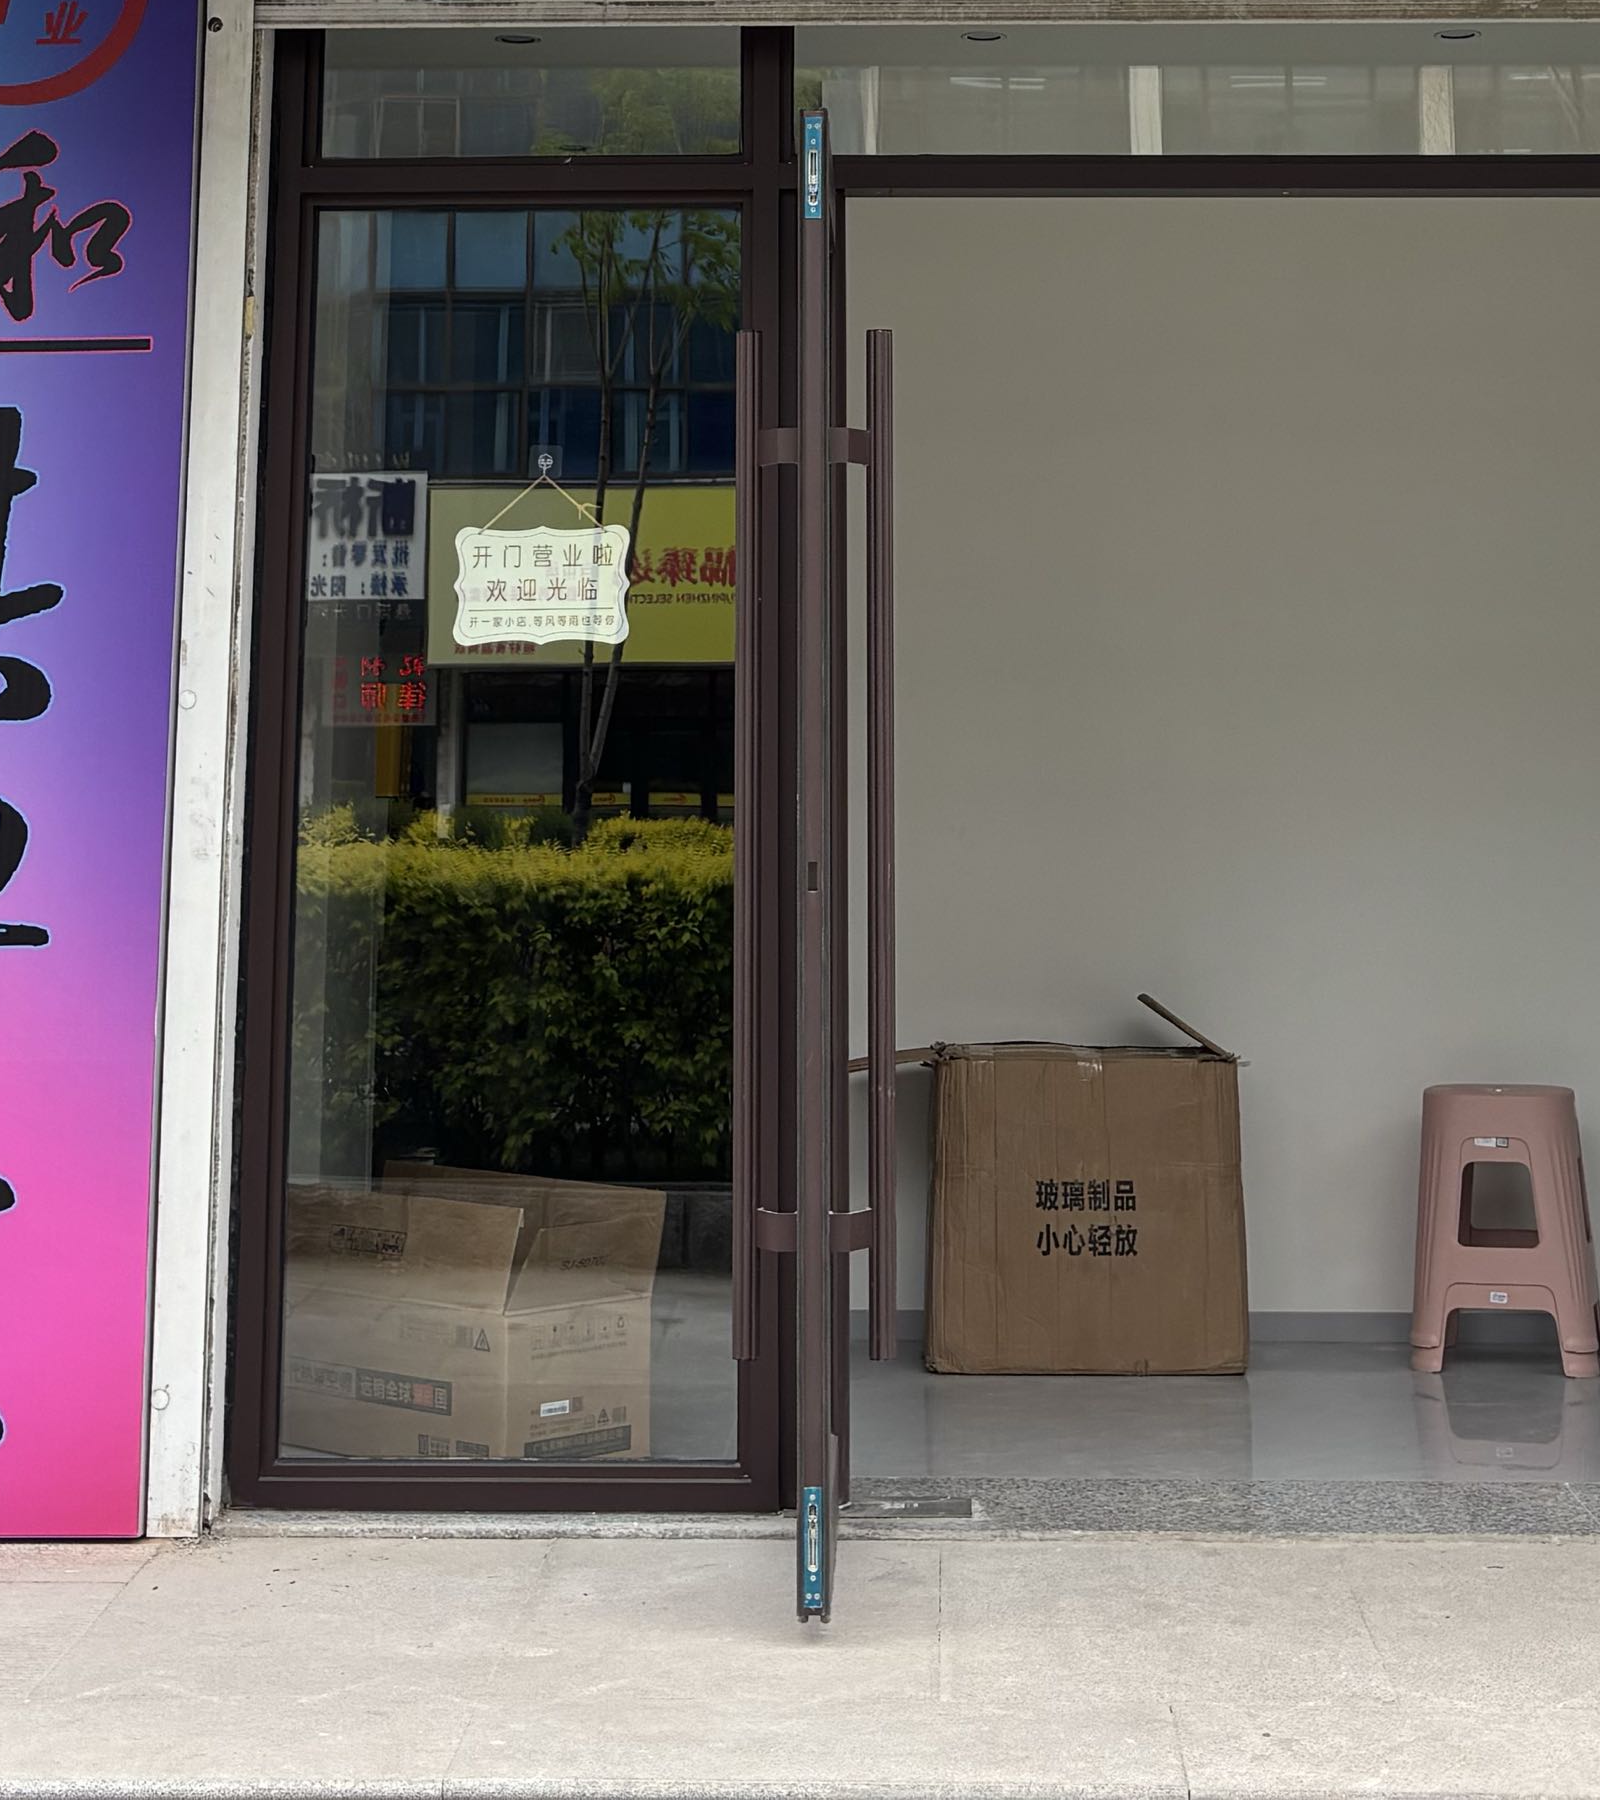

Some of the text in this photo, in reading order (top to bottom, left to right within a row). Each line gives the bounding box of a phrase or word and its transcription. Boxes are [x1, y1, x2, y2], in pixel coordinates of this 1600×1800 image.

[472, 544, 613, 568] 开门营业啦
[487, 578, 598, 602] 欢迎光临
[1035, 1179, 1137, 1211] 玻璃制品
[1036, 1224, 1138, 1257] 小心轻放
